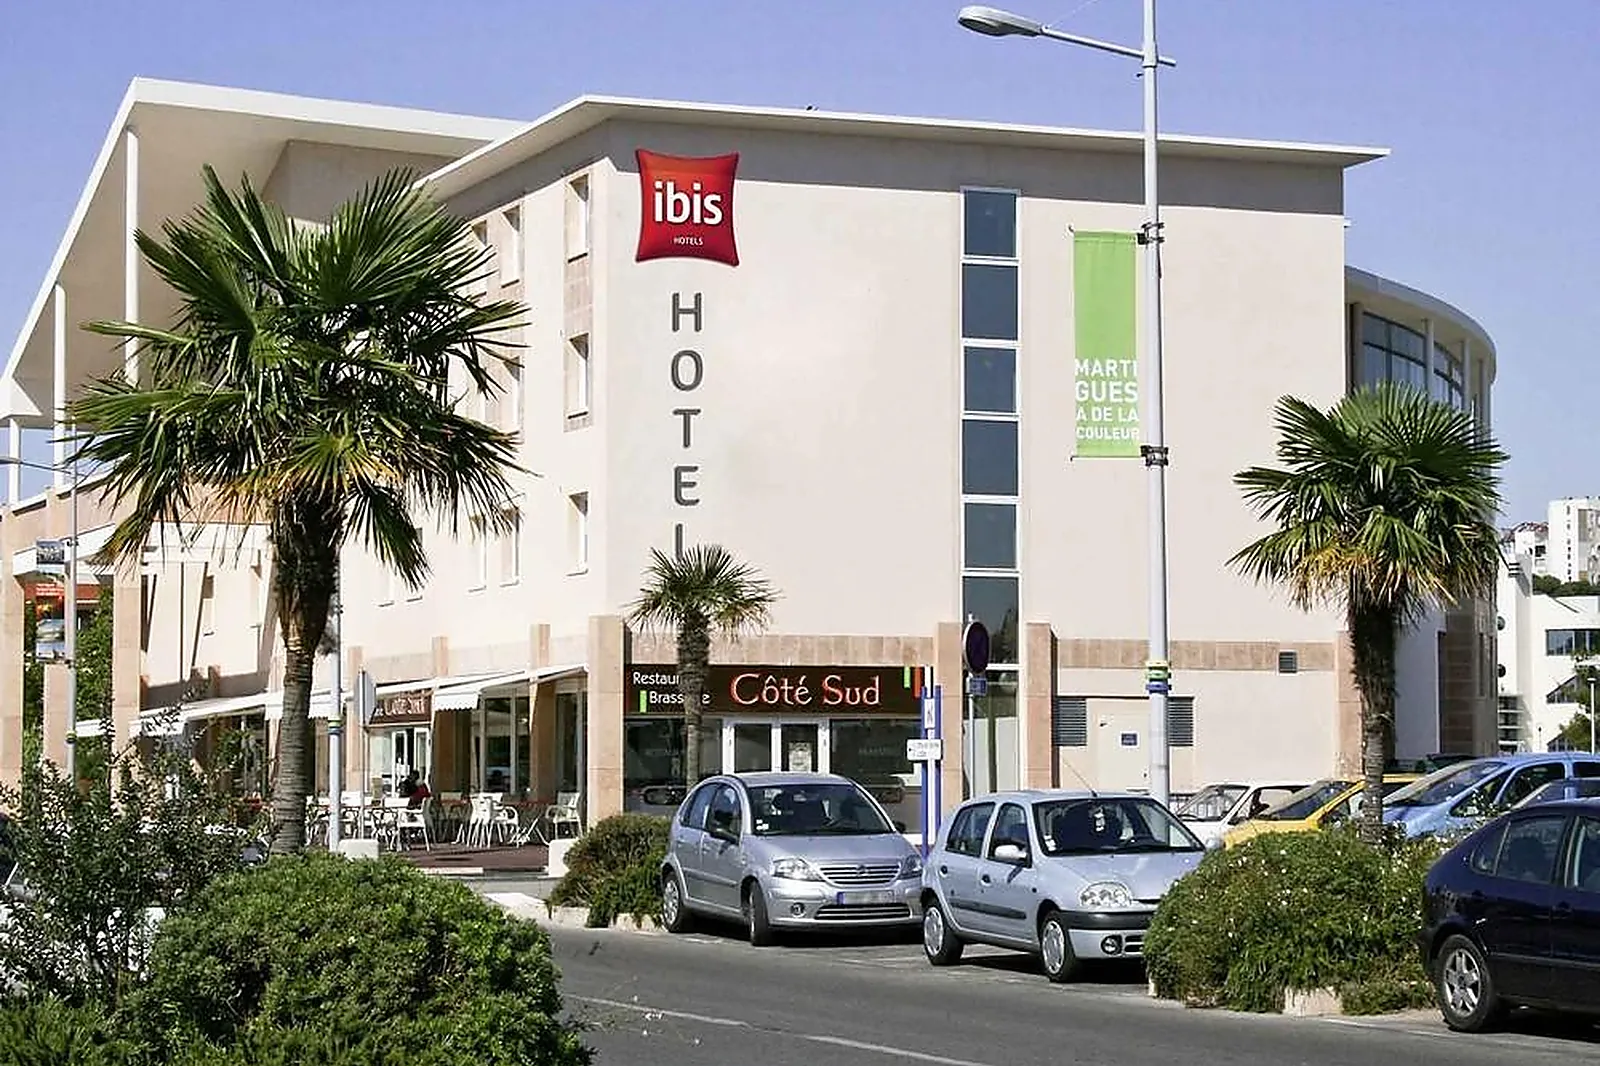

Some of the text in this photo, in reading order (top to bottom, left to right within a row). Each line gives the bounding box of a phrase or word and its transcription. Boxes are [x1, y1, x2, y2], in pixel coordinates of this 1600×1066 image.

[655, 180, 723, 225] ibis
[673, 236, 704, 246] HOTELS
[1075, 358, 1137, 377] MARTI
[1075, 380, 1139, 403] GUES
[1076, 406, 1140, 422] A DE LA
[1076, 425, 1140, 440] COULEUR
[649, 690, 711, 704] Brasse
[731, 673, 880, 705] Côté Sud
